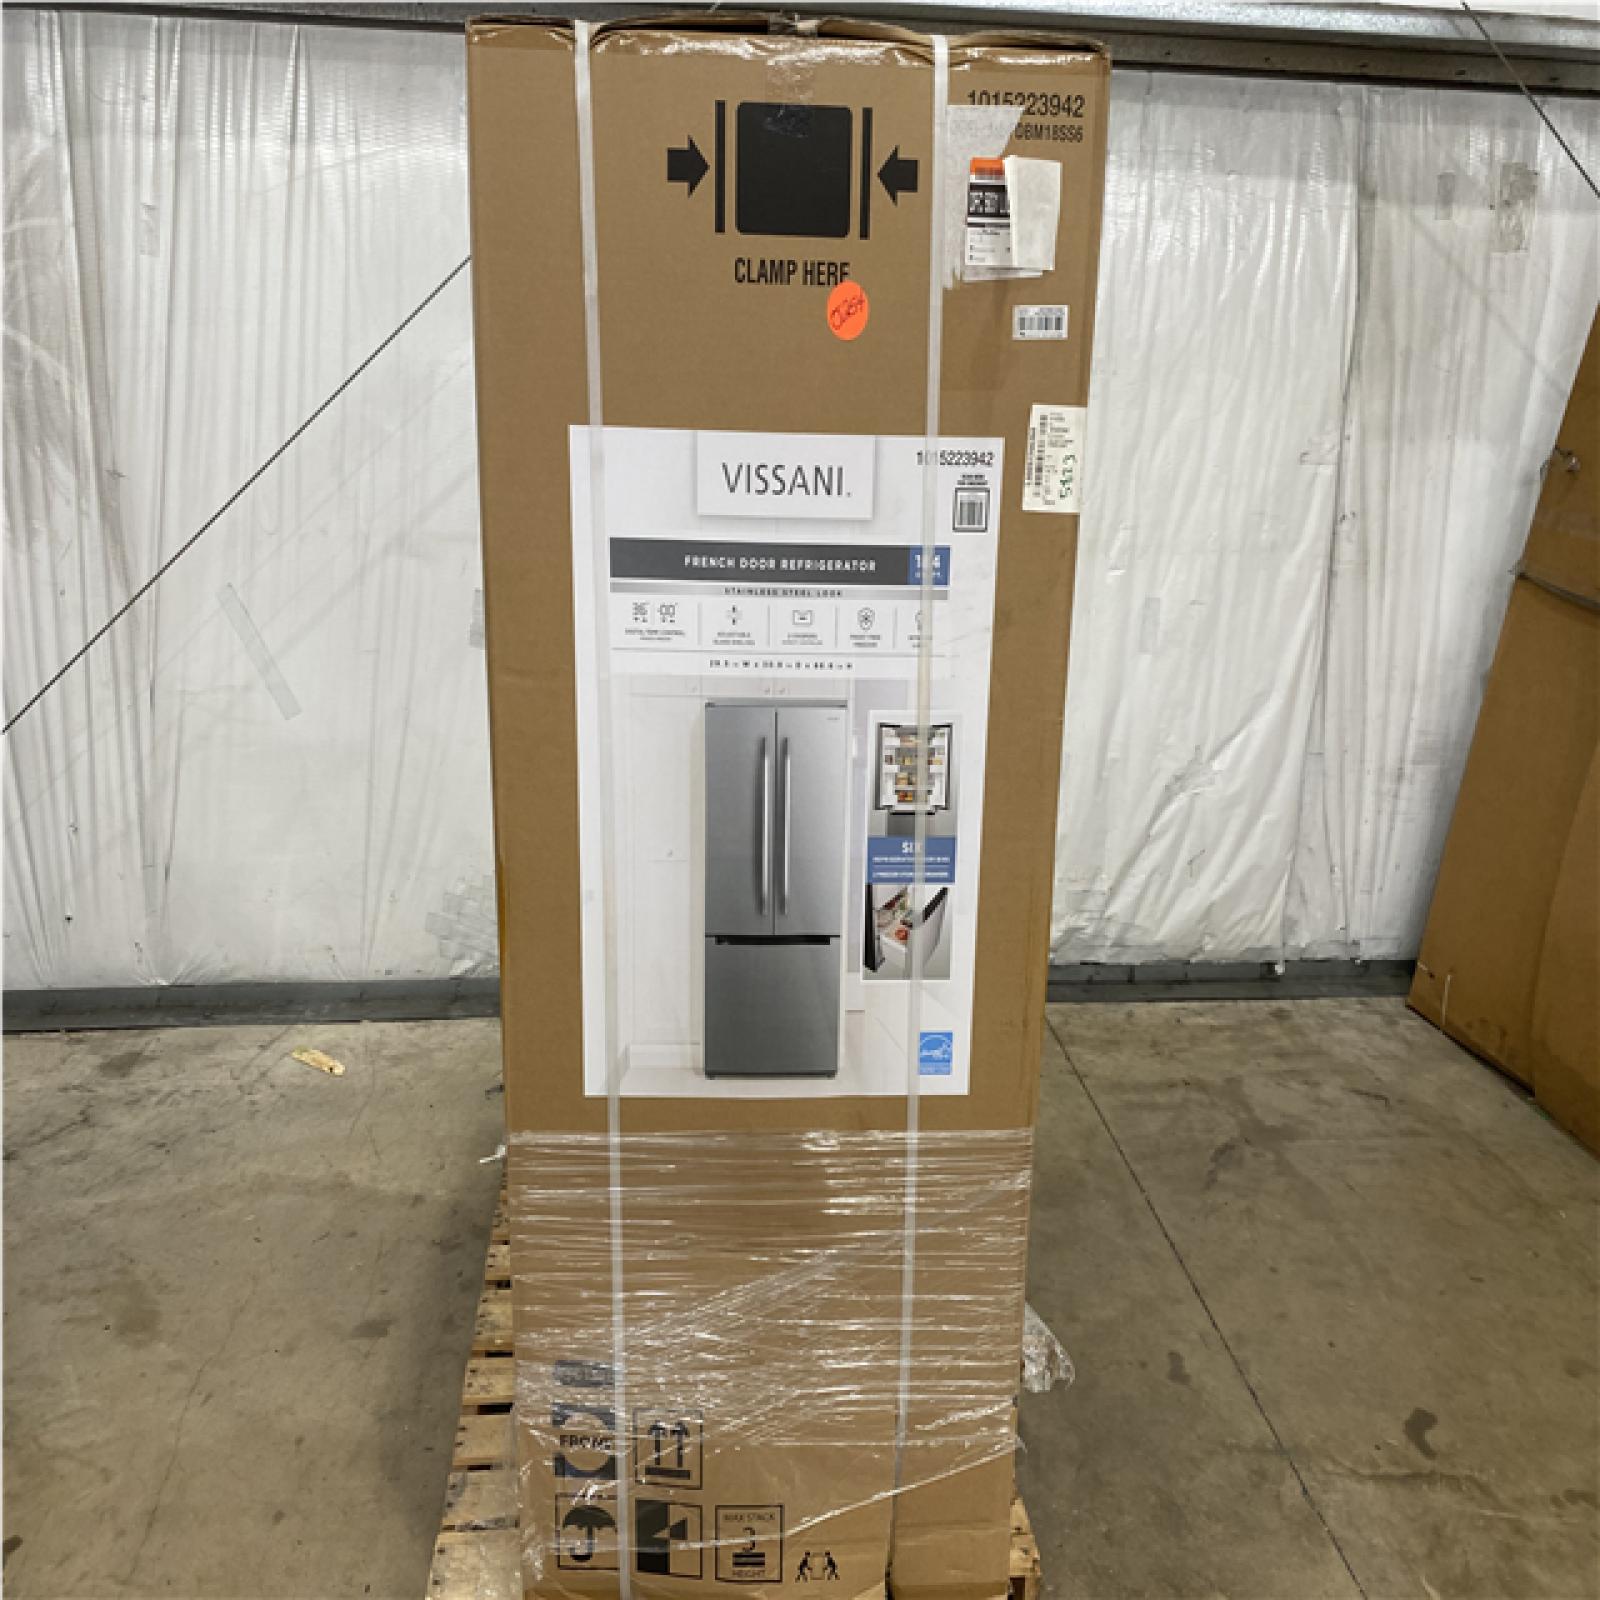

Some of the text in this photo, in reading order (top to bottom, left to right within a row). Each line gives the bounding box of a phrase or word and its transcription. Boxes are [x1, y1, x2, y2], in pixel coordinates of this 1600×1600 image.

[735, 257, 850, 287] CLAMP HERE
[917, 450, 994, 467] 15223942
[685, 554, 876, 572] FRENCH DOOR REFRIGERATOR
